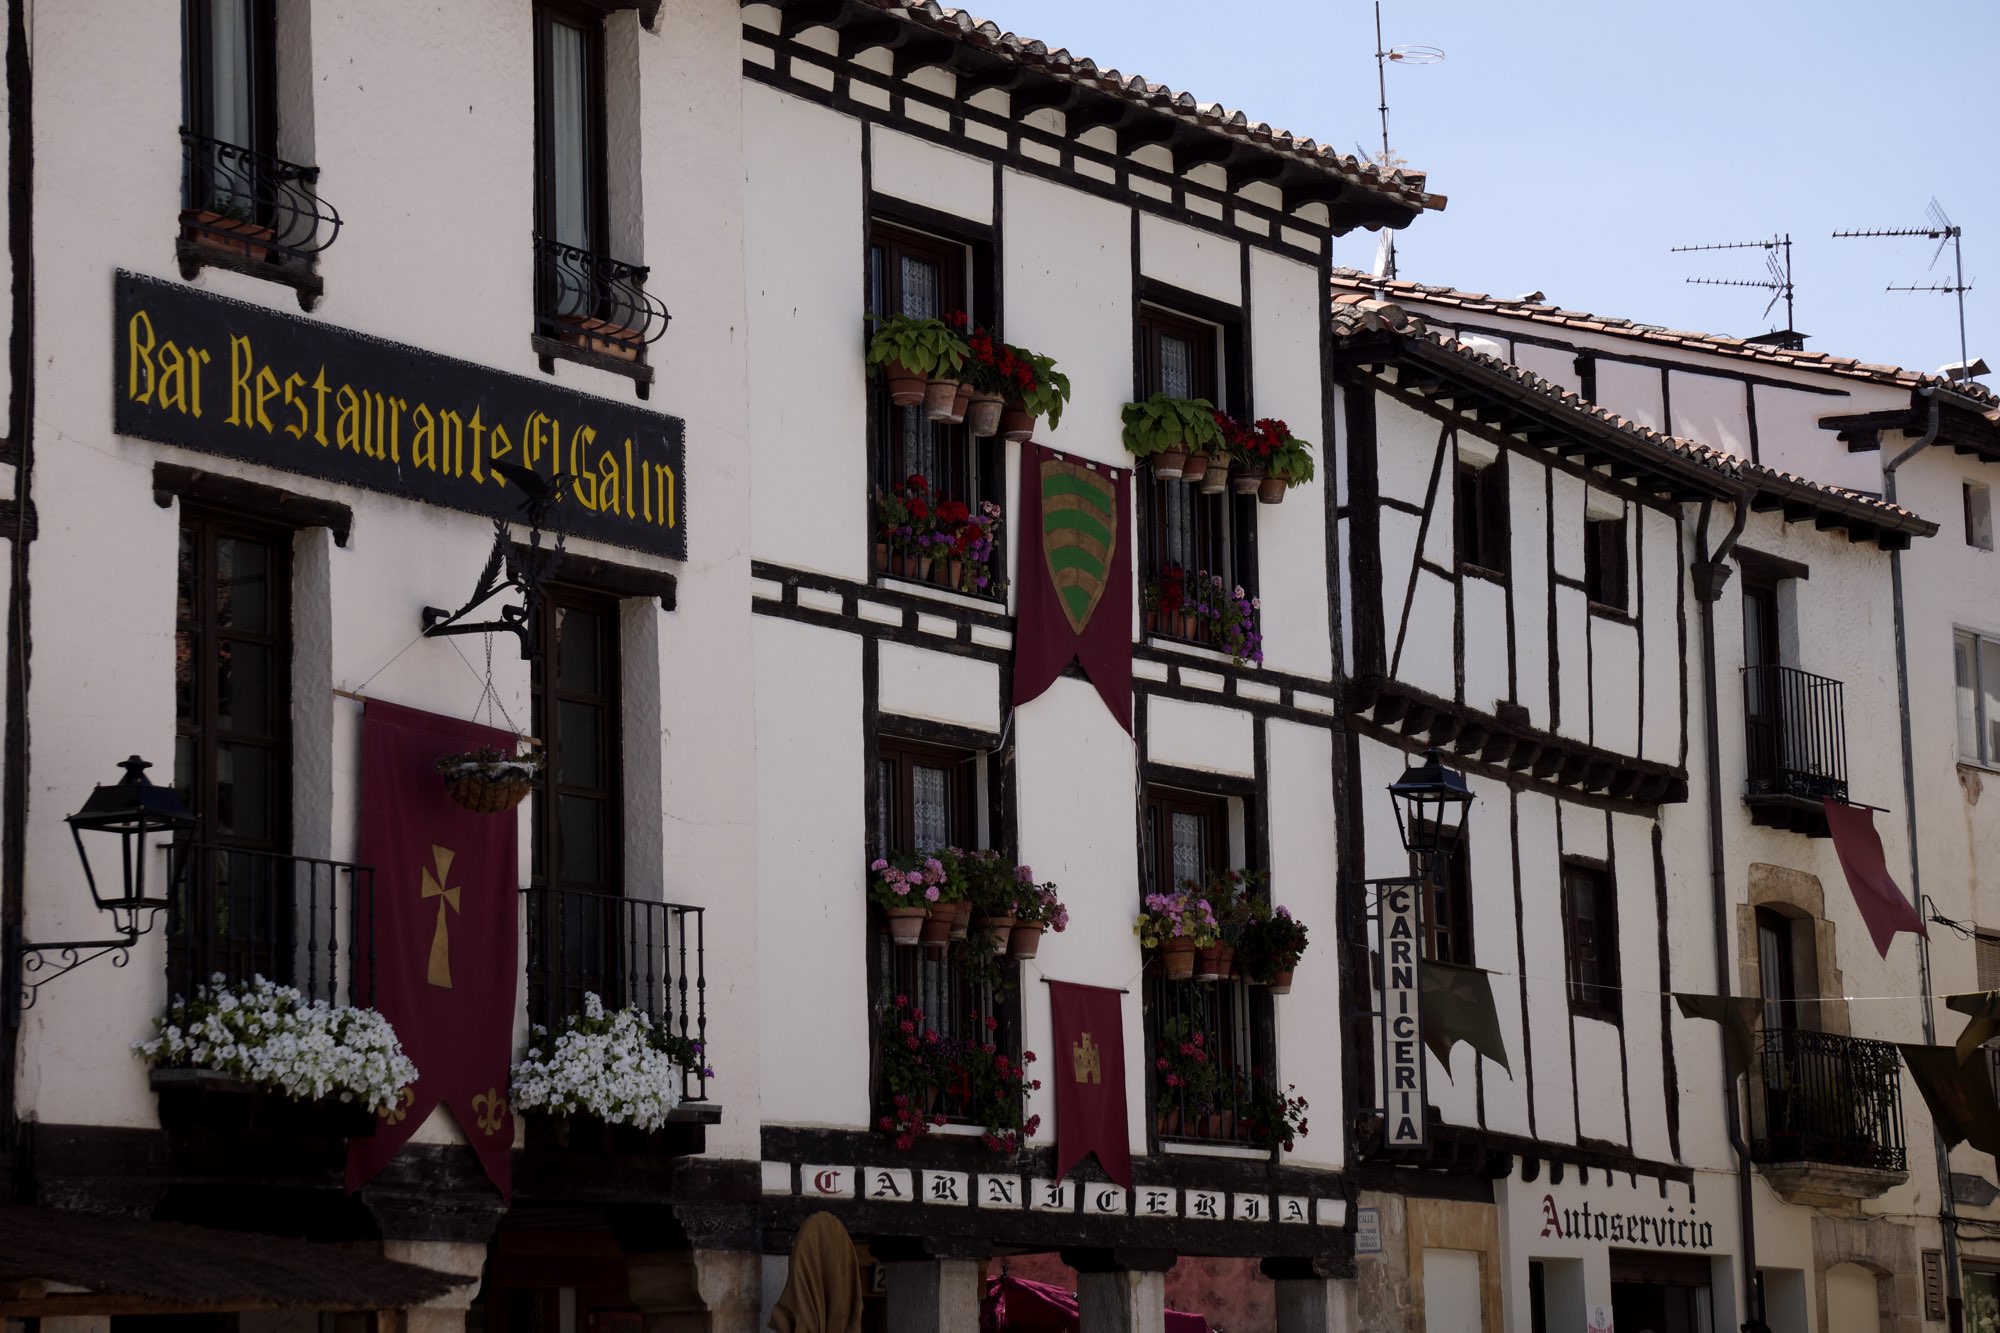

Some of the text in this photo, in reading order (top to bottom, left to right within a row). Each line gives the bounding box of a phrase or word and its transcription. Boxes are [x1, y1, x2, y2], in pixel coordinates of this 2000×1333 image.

[129, 309, 210, 418] Bar
[224, 331, 513, 489] Restaurante
[1389, 890, 1418, 1140] CARNICERIA
[815, 1169, 1303, 1222] CARNICERIA
[1540, 1193, 1713, 1249] Autoservicio
